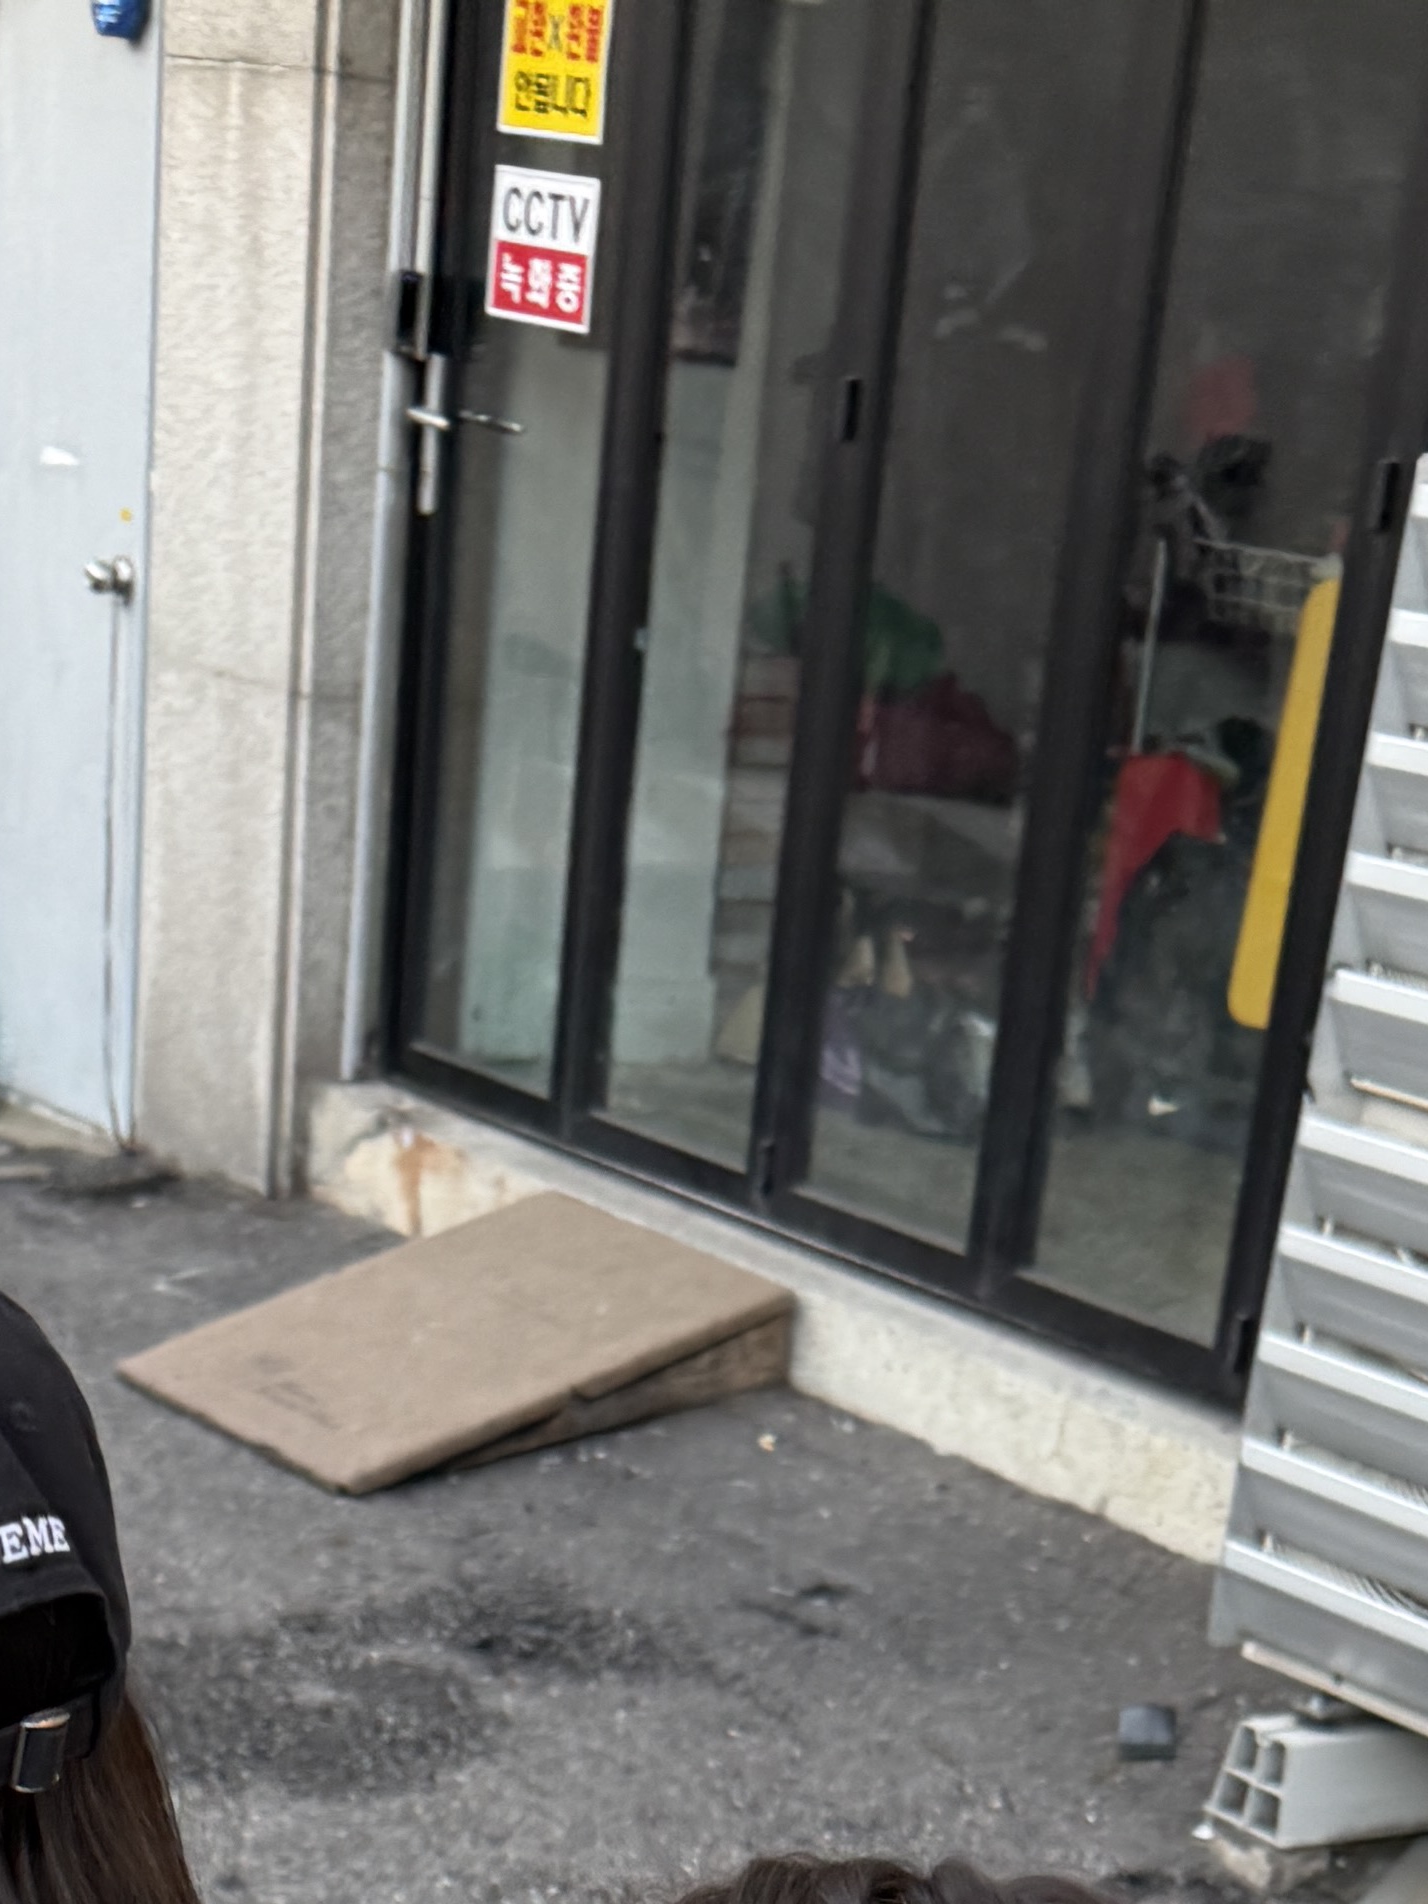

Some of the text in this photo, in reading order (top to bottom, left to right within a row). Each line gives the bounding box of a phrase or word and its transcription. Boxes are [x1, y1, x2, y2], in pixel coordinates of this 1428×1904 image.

[514, 70, 591, 119] 안됩니다
[502, 186, 590, 243] CCTV
[499, 252, 582, 313] 녹화중
